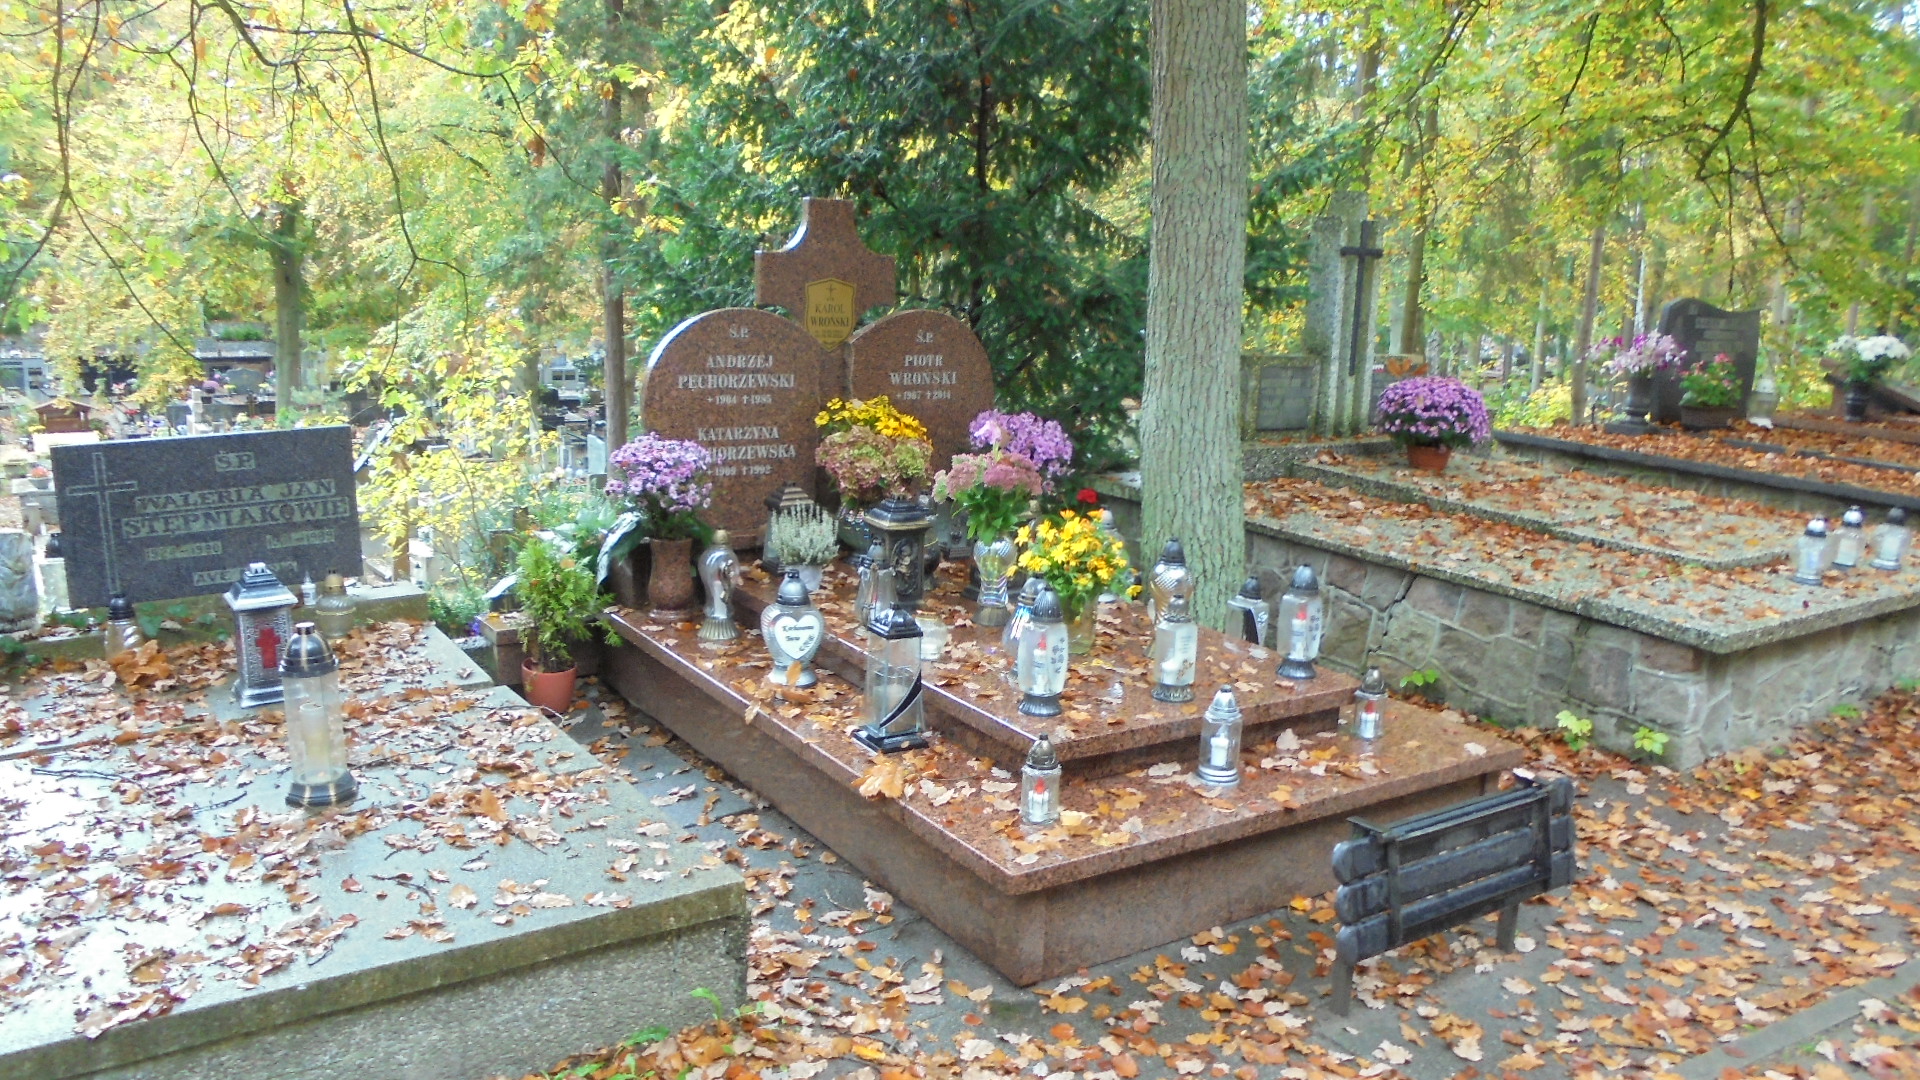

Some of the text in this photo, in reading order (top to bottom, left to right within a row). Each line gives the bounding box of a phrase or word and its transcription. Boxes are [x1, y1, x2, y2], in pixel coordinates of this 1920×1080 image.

[815, 303, 846, 314] KAROL
[706, 354, 773, 368] ANDRZEJ
[904, 353, 943, 367] PIOTR
[678, 373, 795, 391] PĘCHORZEWSKI
[698, 426, 780, 440] KATARZYNA
[708, 443, 796, 461] HORZEWSKA
[136, 479, 334, 511] WALERIA JAN
[123, 500, 348, 536] STĘPNIAKOWIE
[195, 570, 231, 584] AVE
